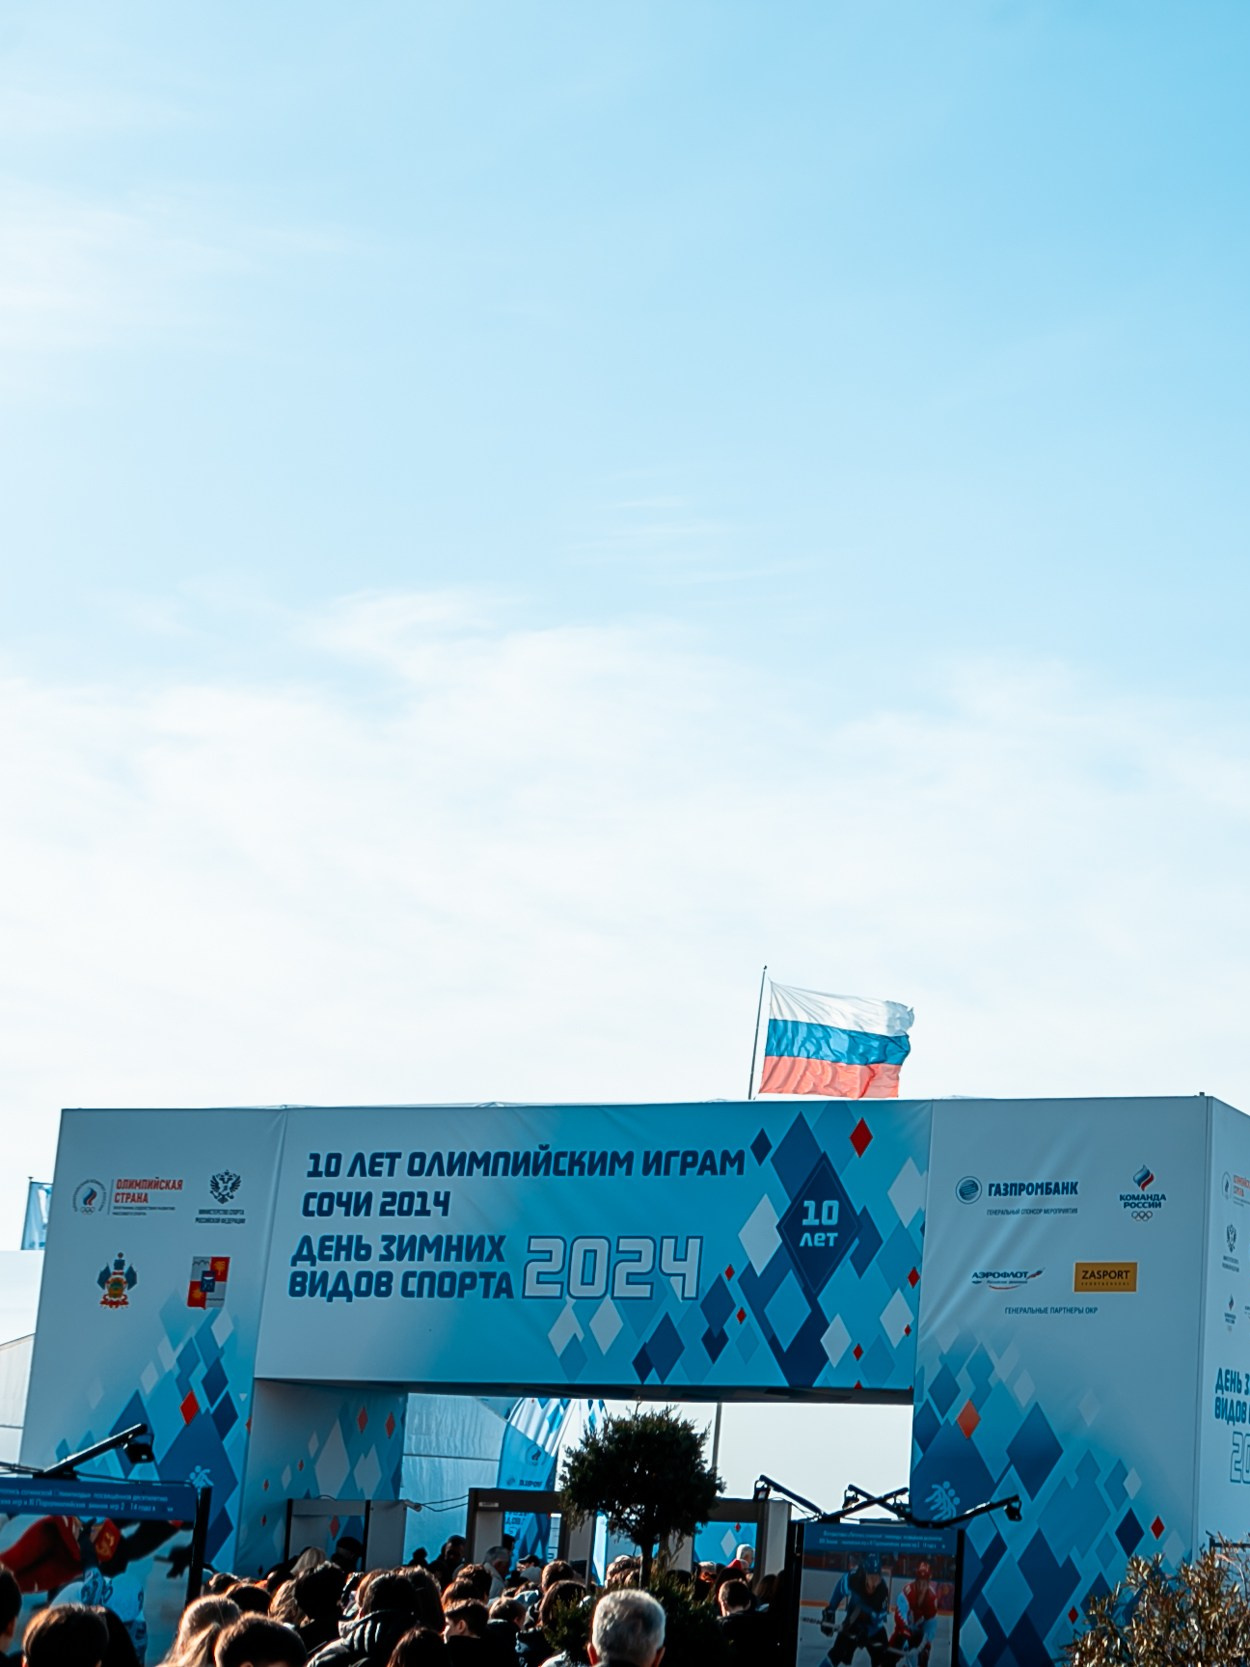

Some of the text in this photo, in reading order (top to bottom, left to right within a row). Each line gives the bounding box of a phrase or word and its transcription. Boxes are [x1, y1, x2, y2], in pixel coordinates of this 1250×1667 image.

[306, 1145, 745, 1177] 10 ЛЕТ ОЛИМПИЙСКИМ ИГРАМ
[116, 1177, 183, 1190] ОЛИМПИЙСКАЯ
[988, 1181, 1078, 1196] ГАЗПРОМБАНК
[114, 1192, 149, 1203] СТРАНА
[302, 1191, 450, 1217] СОЧИ 2014
[1119, 1194, 1166, 1202] КОМАНДА
[1123, 1201, 1162, 1209] РОССИИ
[802, 1200, 839, 1226] 10
[290, 1234, 506, 1267] ДЕНЬ ЗИМНИХ
[521, 1235, 703, 1300] 2024
[972, 1271, 1029, 1279] АЭРОФЛОТ
[1081, 1270, 1130, 1280] ZASPORT
[288, 1270, 515, 1302] ВИДОВ СПОРТА
[1005, 1306, 1098, 1314] ГЕНЕРАЛЬНЫЕ ПАРТНЕРЫ ОКР
[1215, 1367, 1242, 1395] ДЕНЬ
[1215, 1396, 1247, 1426] ВИДОВ
